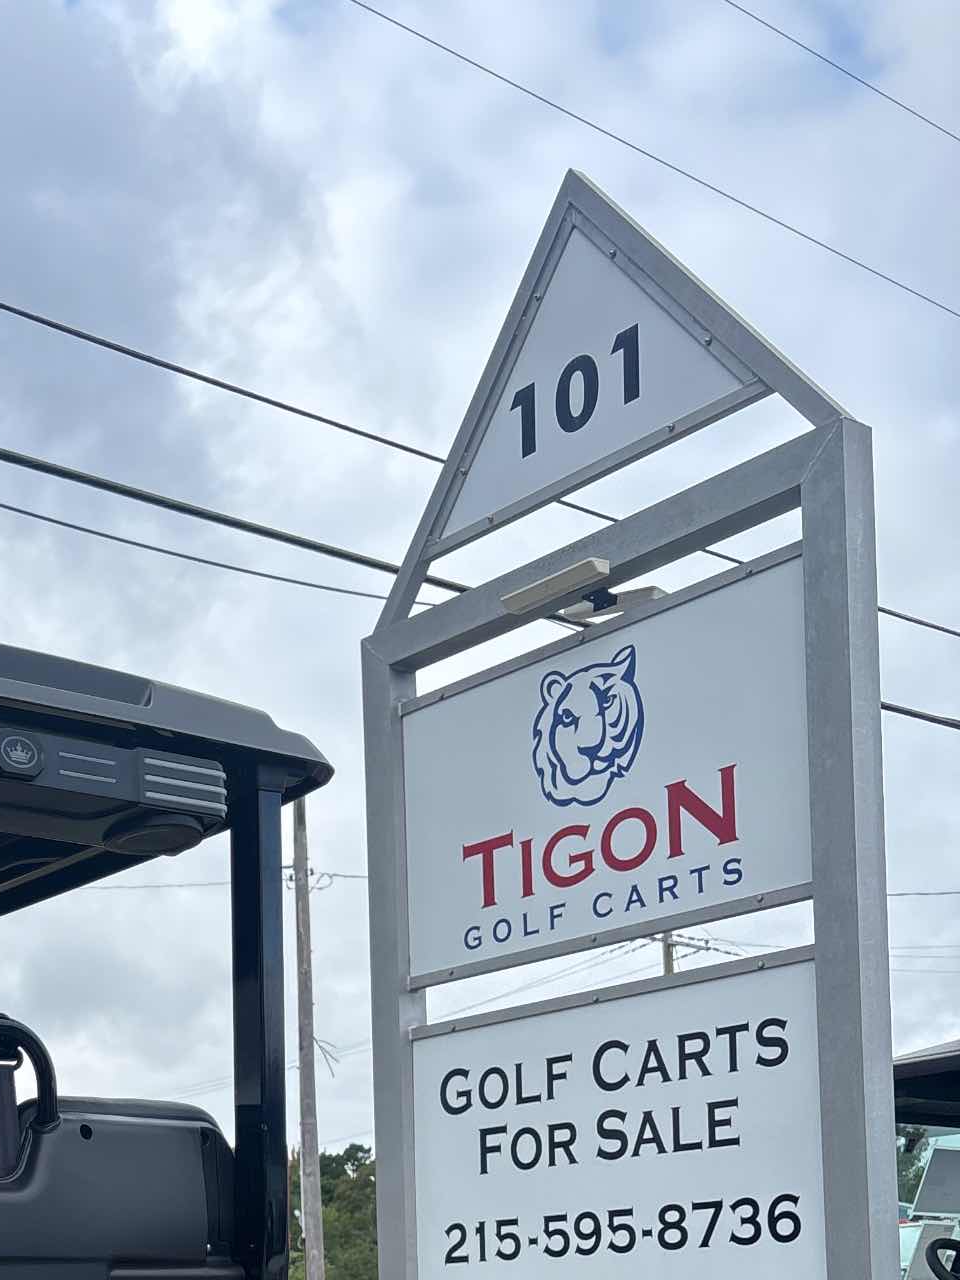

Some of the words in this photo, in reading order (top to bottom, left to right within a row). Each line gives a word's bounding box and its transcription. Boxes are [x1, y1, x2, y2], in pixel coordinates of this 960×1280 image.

[509, 322, 640, 459] 101
[463, 763, 739, 909] TIGON
[463, 902, 567, 951] GOLF
[592, 857, 743, 919] CARTS
[439, 1052, 573, 1116] GOLF
[592, 1017, 790, 1092] CARTS
[478, 1121, 579, 1176] FOR
[596, 1096, 741, 1161] SALE
[444, 1193, 802, 1265] 215-595-8736
